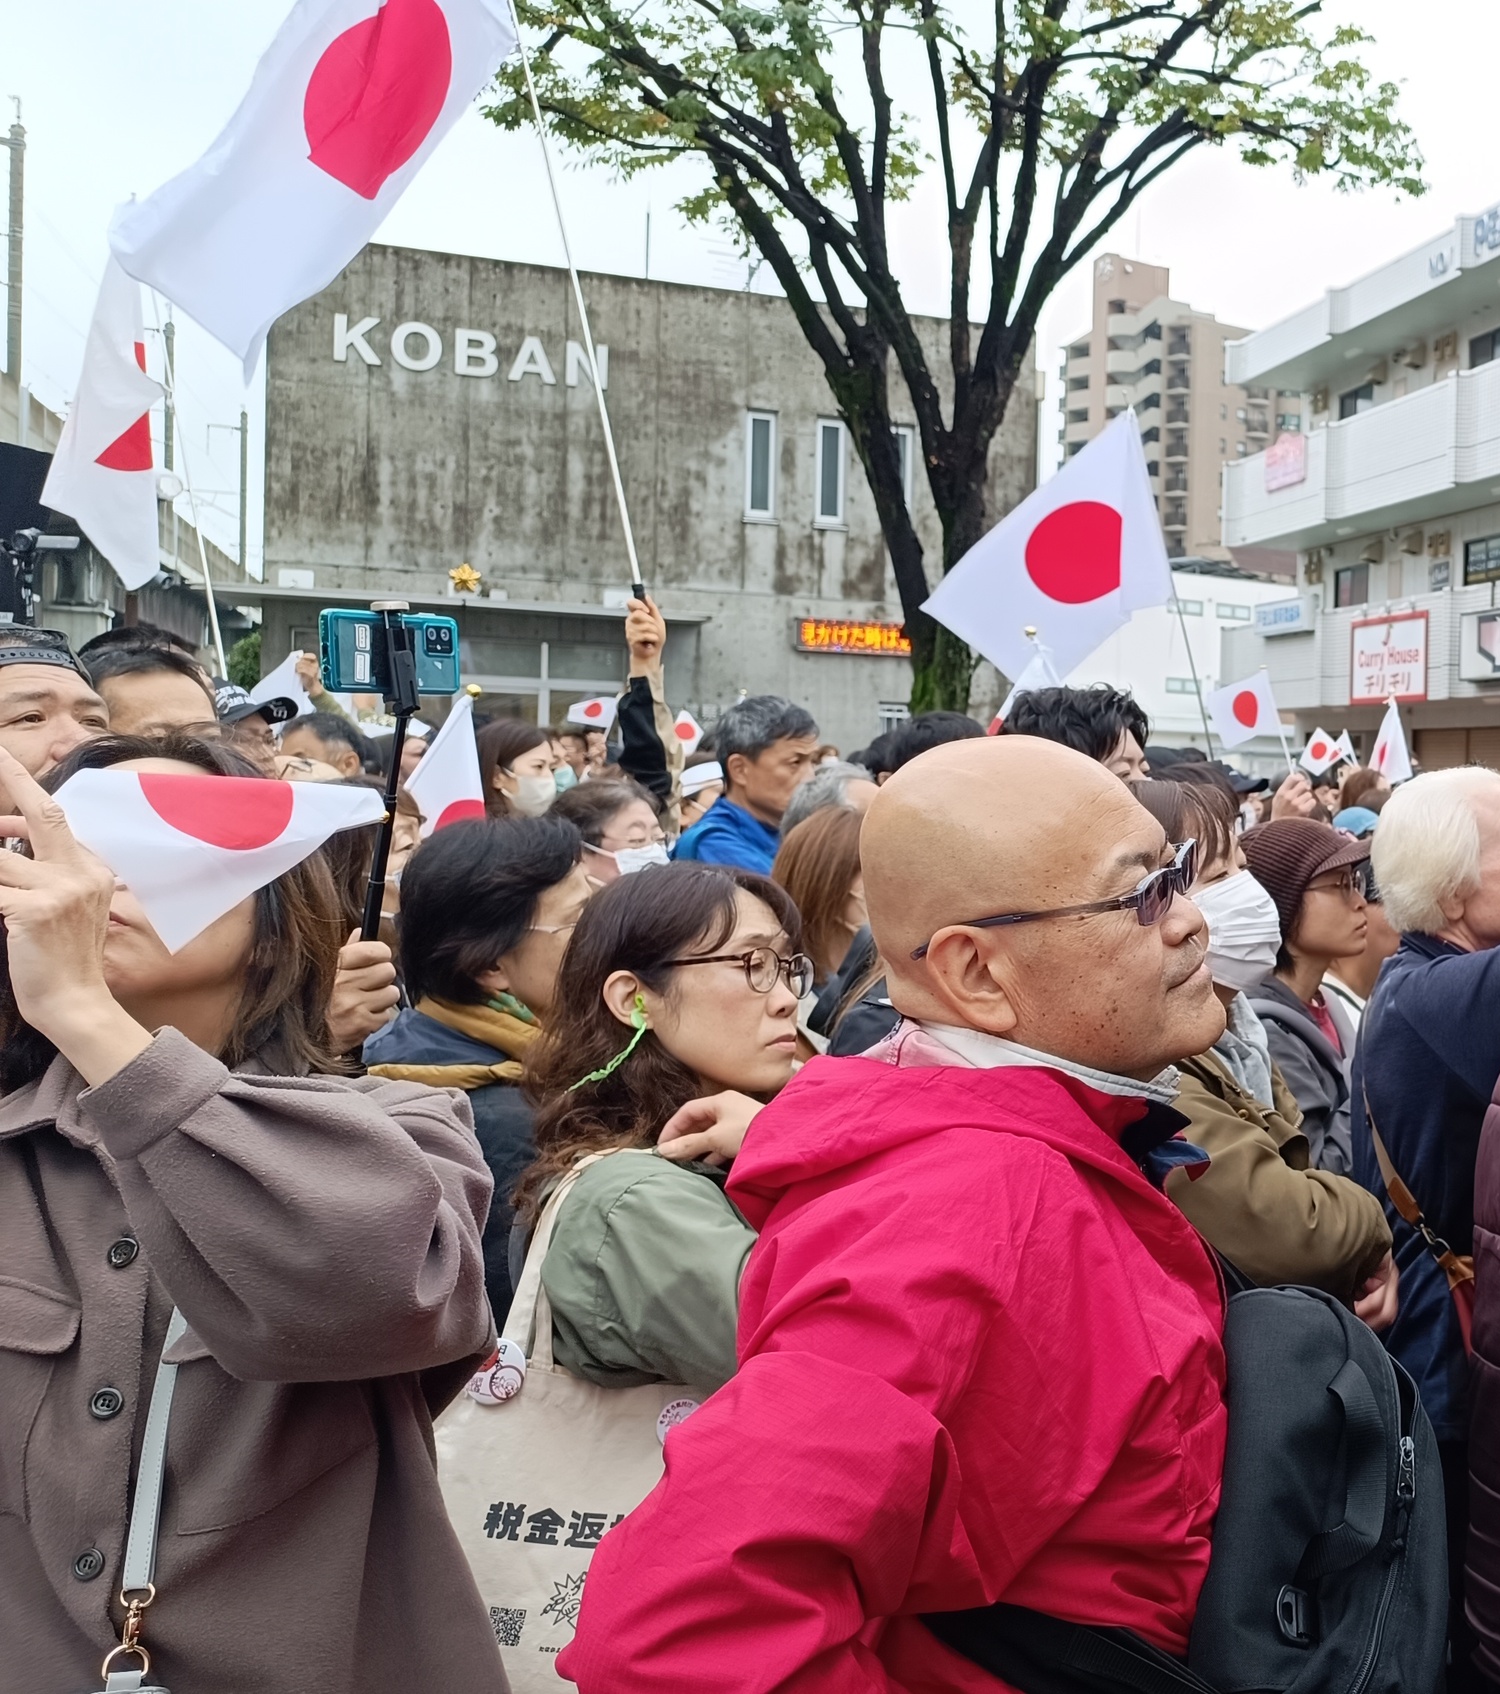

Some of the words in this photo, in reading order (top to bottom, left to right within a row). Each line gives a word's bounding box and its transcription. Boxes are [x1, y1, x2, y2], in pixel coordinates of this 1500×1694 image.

[333, 312, 609, 391] KOBAN
[1358, 649, 1385, 671] Curry
[1387, 645, 1419, 666] House
